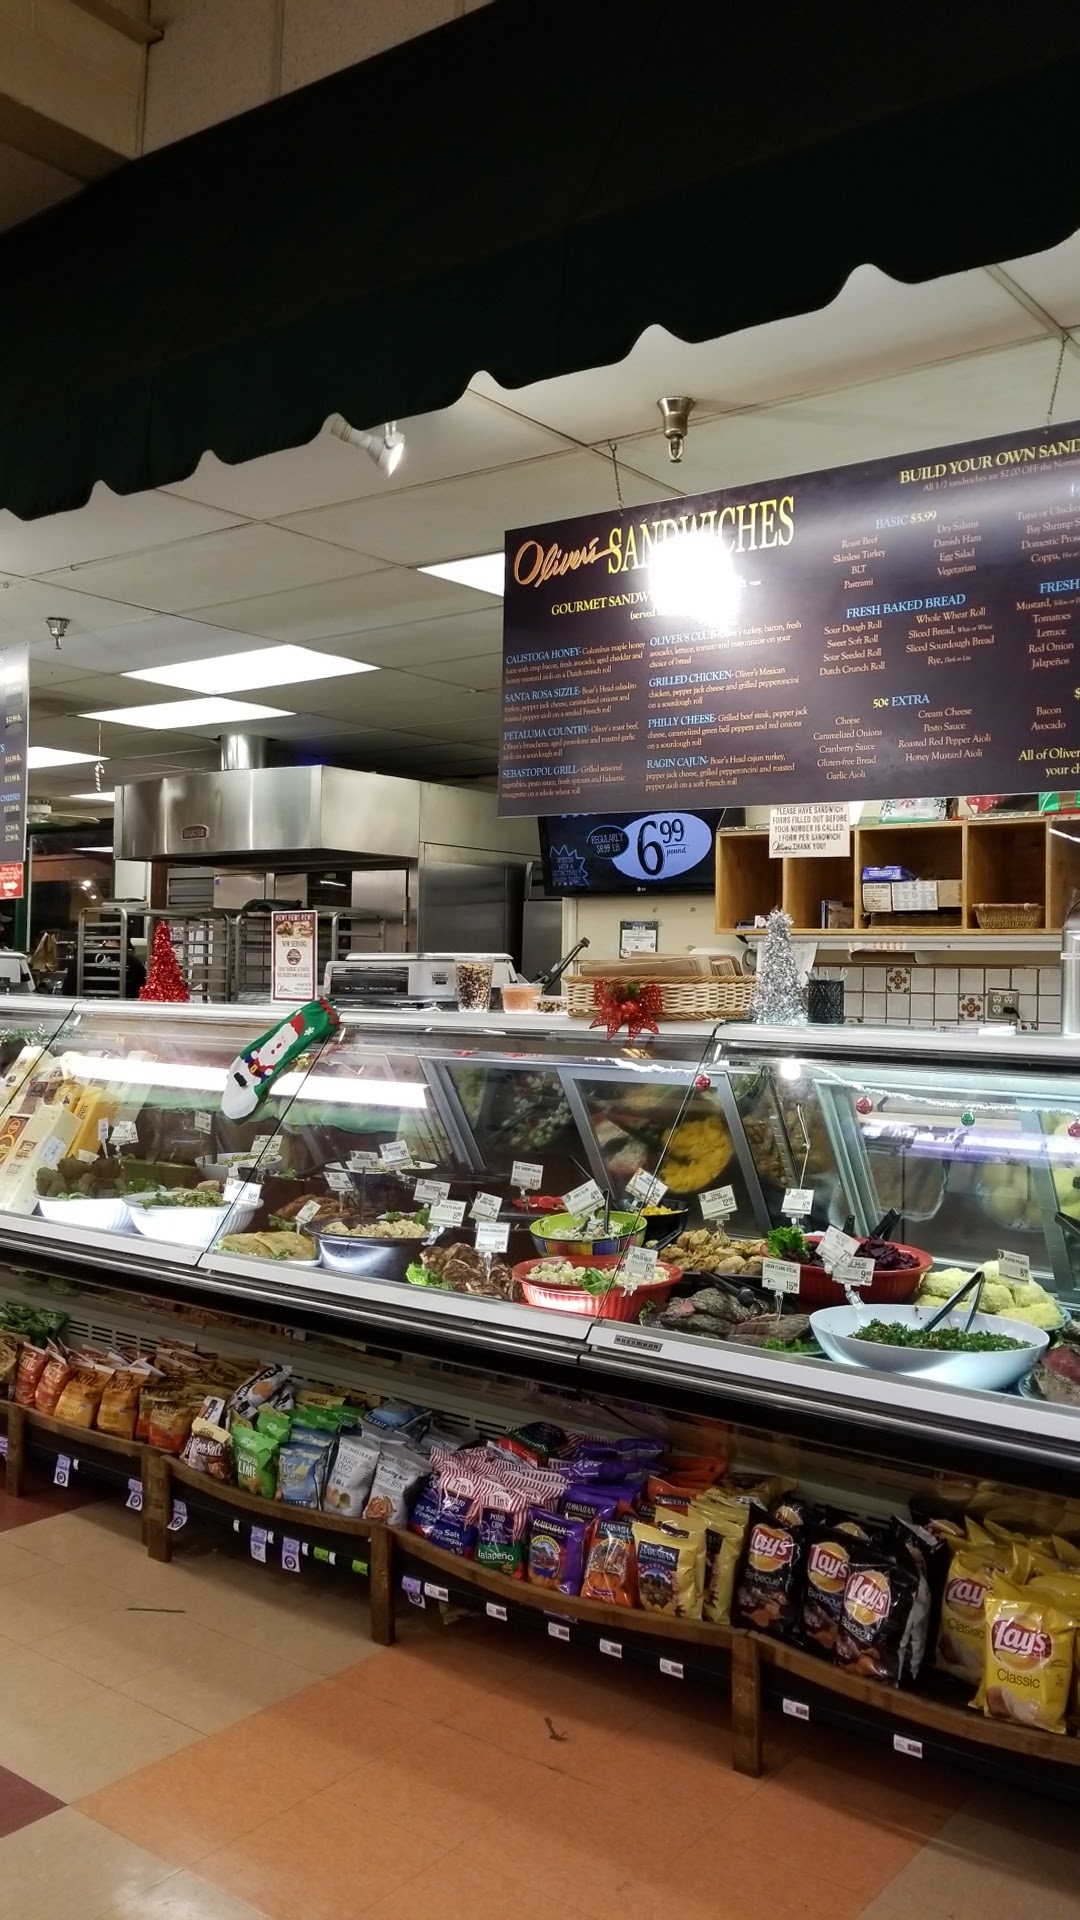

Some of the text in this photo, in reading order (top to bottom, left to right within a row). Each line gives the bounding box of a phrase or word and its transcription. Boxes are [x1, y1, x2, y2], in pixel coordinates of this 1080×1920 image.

[901, 464, 946, 484] BUILD
[948, 456, 992, 474] YOUR
[996, 446, 1037, 465] OWN
[1021, 462, 1053, 473] OFF the
[876, 510, 937, 529] BASIC $5.99
[953, 520, 978, 531] Salami
[1027, 520, 1073, 534] Bay Shrimp
[842, 536, 878, 548] Roast Beef
[933, 535, 981, 548] Danish Ham
[1022, 537, 1059, 549] Domestic
[833, 550, 886, 564] Skinless Turkey
[940, 548, 975, 561] Egg Salad
[851, 564, 866, 574] BLT
[937, 564, 976, 576] Vegetarian
[844, 578, 873, 589] Pastrami
[552, 598, 607, 615] GOURMET
[846, 594, 966, 618] FRESH BAKED BREAD
[916, 607, 985, 624] Whole Wheat Roll
[1032, 613, 1071, 623] Tomatoes
[824, 620, 882, 635] Sour Dough Roll
[909, 626, 956, 639] Sliced Bread,
[1037, 629, 1067, 637] Lettuce
[827, 635, 878, 648] Sweet Soft Roll
[906, 635, 994, 653] Sliced Sourdough Bread
[1029, 642, 1074, 653] Red Onion
[506, 653, 550, 664] CALISTOGA
[823, 648, 881, 662] Sour Seeded Roll
[819, 661, 885, 676] Dutch Crunch Roll
[1031, 658, 1070, 669] Jalapeños
[649, 675, 687, 687] GRILLED
[505, 694, 530, 702] SANTA
[532, 690, 552, 699] ROSA
[873, 694, 930, 708] 50¢ EXTRA
[918, 707, 972, 718] Cream Cheese
[1036, 707, 1061, 715] Bacon
[648, 717, 679, 728] PHILLY
[835, 716, 860, 726] Cheese
[924, 722, 966, 732] Pesto Sauce
[1031, 720, 1066, 730] Avocado
[504, 730, 546, 740] PETALUMA
[814, 729, 882, 741] Caramelized Onions
[898, 734, 991, 748] Roasted Red Pepper Aioli
[819, 743, 875, 754] Cranberry Sauce
[857, 756, 876, 764] Bread
[905, 749, 983, 762] Honey Mustard Aioli
[1018, 749, 1048, 761] All of
[647, 758, 675, 769] RAGIN
[503, 768, 552, 778] SEBASTOPOL
[826, 770, 865, 780] Garlic Aioli
[1045, 767, 1069, 777] your
[826, 814, 847, 822] BEFORE
[591, 833, 624, 844] REGULARLY
[667, 847, 687, 857] pound
[238, 1461, 256, 1477] LIME
[453, 1480, 471, 1494] Tim's
[565, 1502, 597, 1515] HAWAIIAN
[444, 1530, 460, 1538] Salt
[752, 1528, 792, 1557] Lay's
[810, 1544, 848, 1579] Lay's
[744, 1569, 780, 1587] Barbecue
[851, 1573, 889, 1612] Lay's
[841, 1616, 874, 1643] Barbecue
[948, 1619, 985, 1640] Classic
[994, 1621, 1047, 1654] Lay's
[996, 1668, 1041, 1689] Classic
